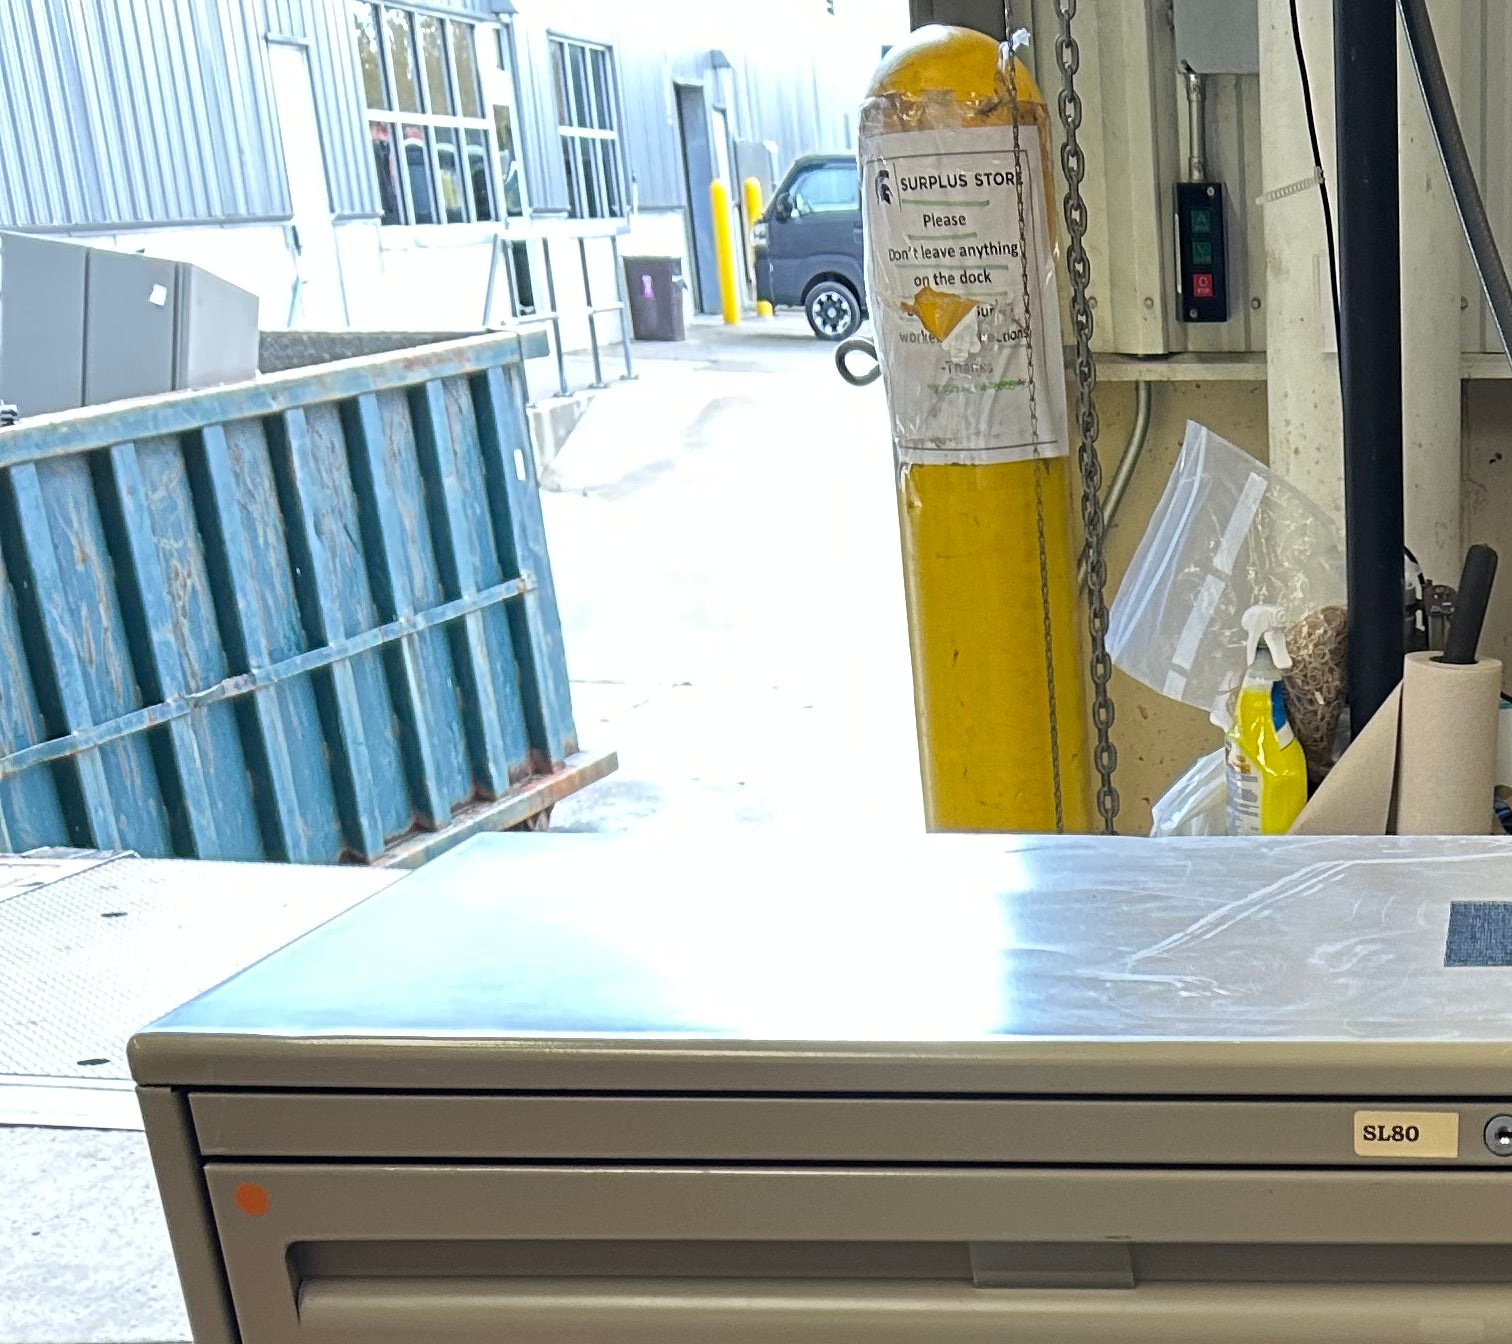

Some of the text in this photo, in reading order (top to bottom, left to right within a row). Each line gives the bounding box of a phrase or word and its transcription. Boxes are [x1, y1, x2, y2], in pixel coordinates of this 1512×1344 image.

[900, 173, 968, 191] SURPLUS
[923, 212, 967, 228] Please
[888, 240, 1019, 261] Don't leave anything
[932, 271, 956, 286] the
[960, 268, 992, 285] dock
[1362, 1124, 1420, 1143] SL80
